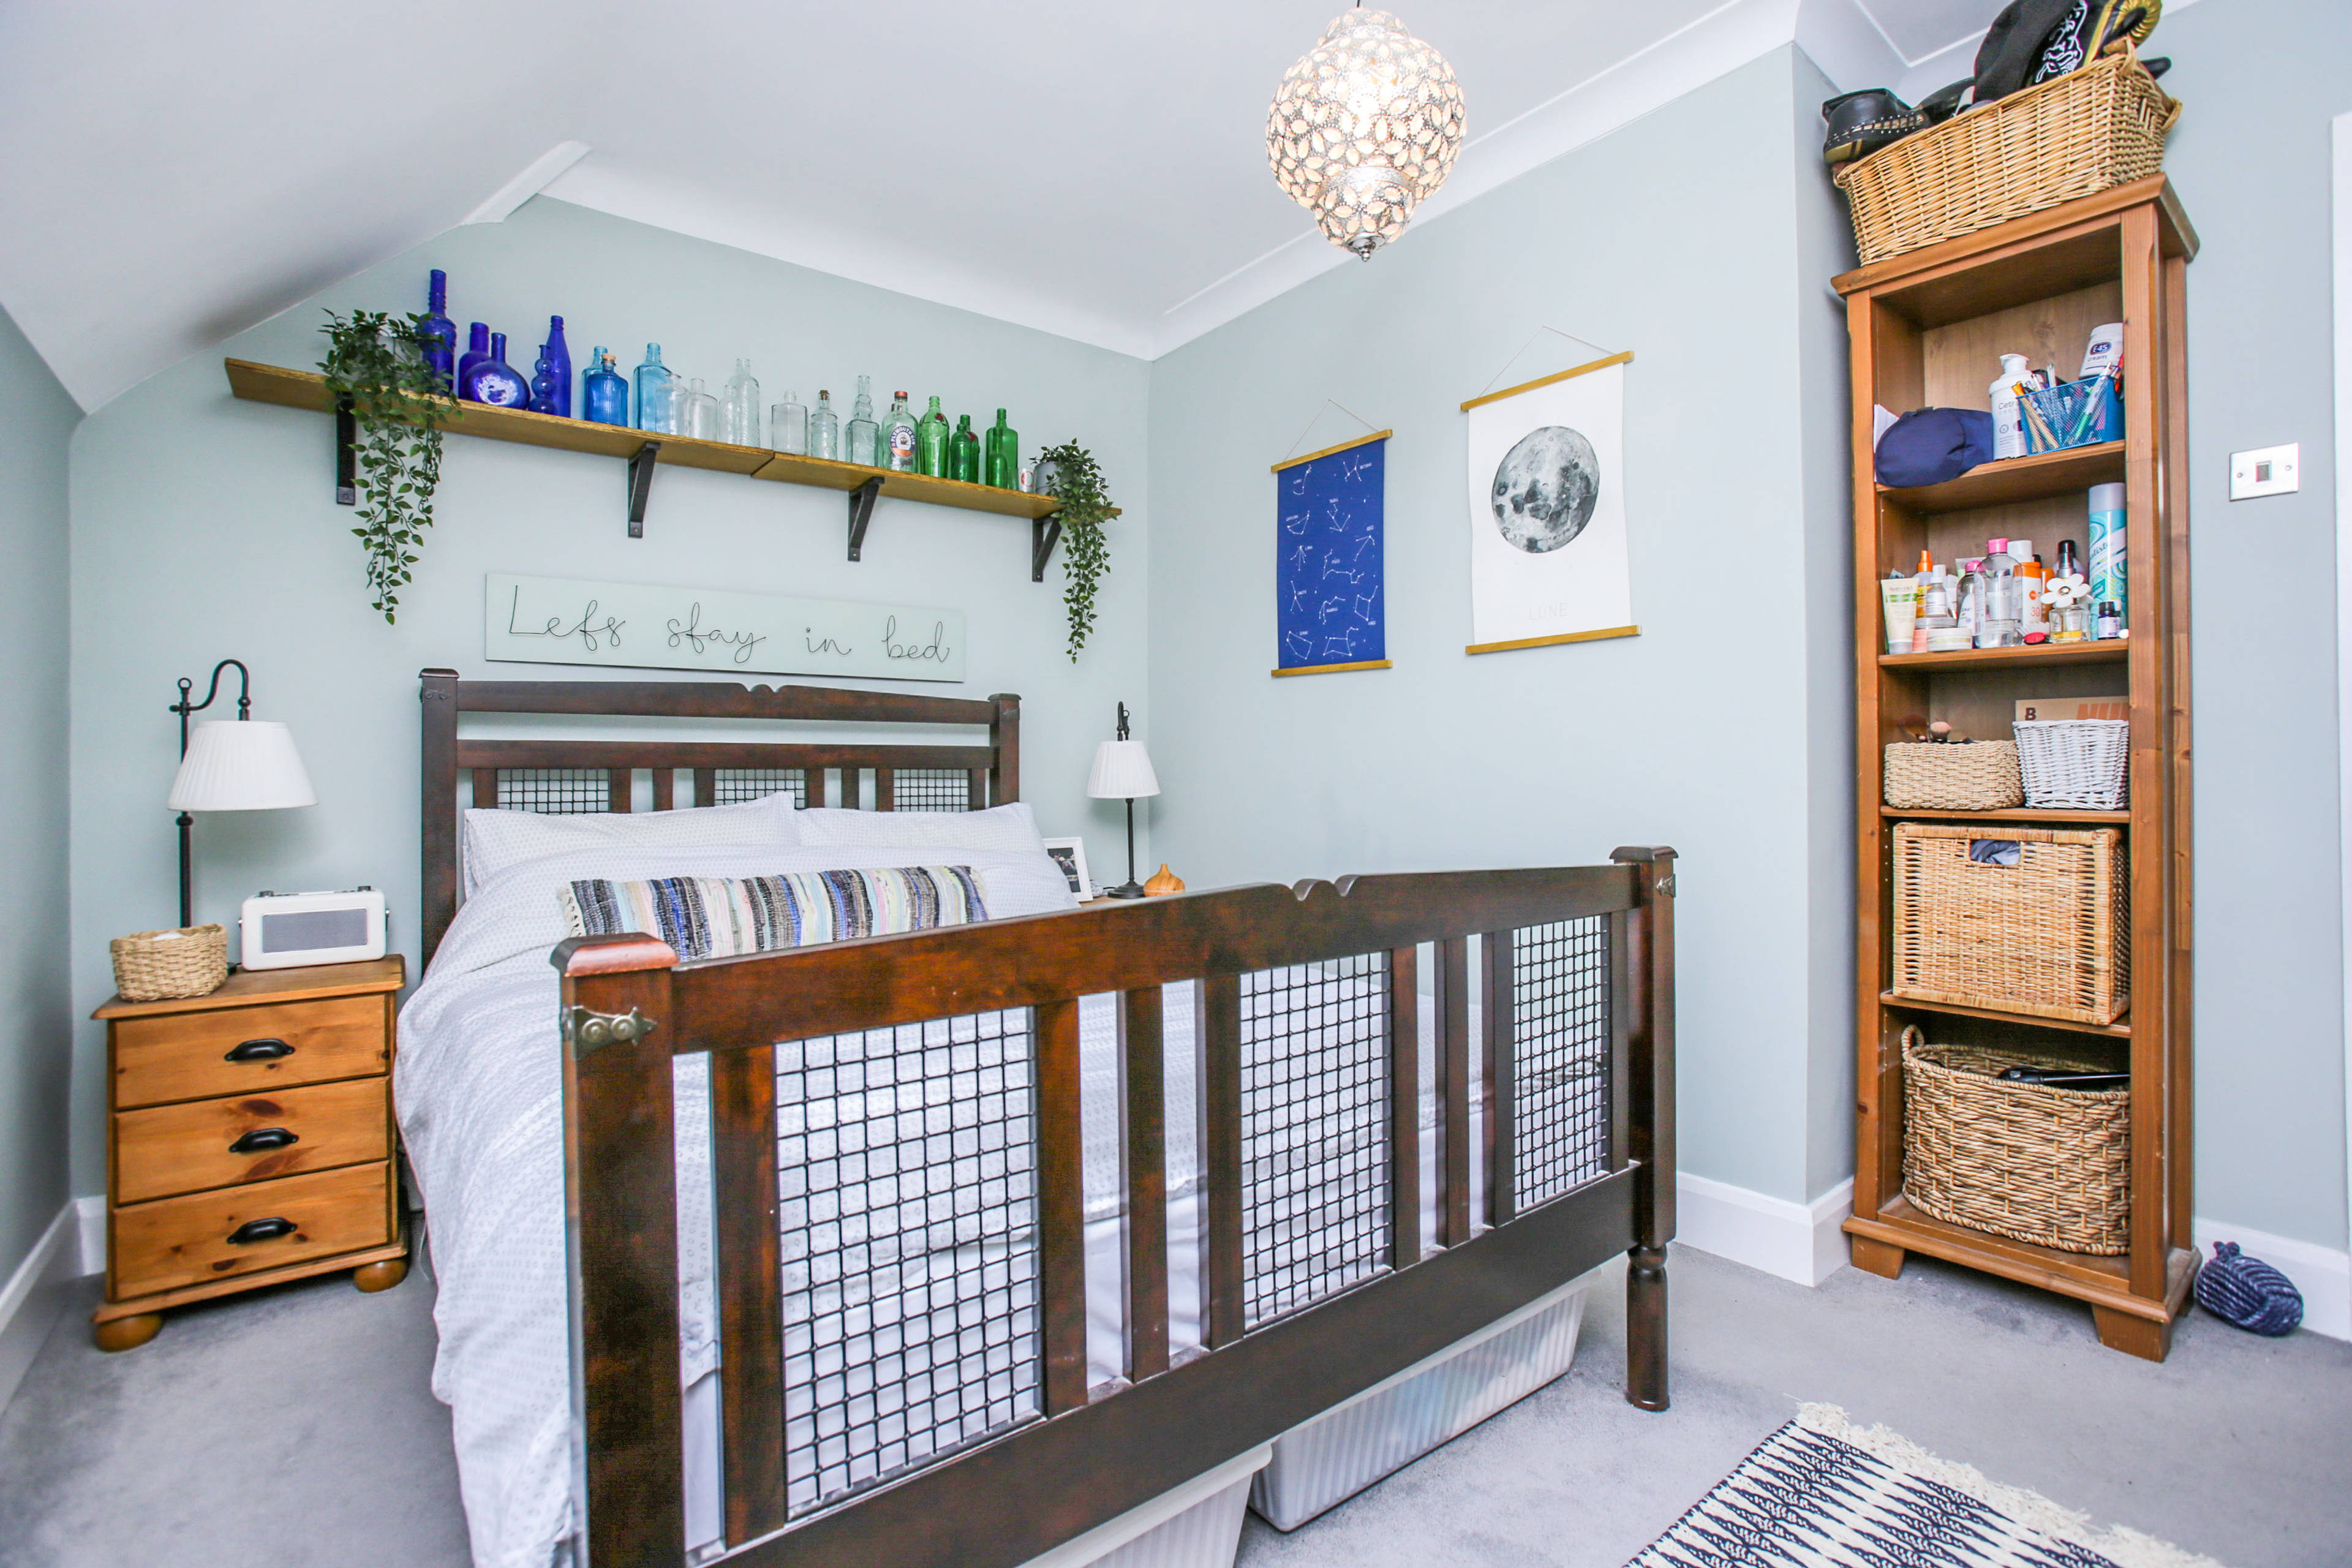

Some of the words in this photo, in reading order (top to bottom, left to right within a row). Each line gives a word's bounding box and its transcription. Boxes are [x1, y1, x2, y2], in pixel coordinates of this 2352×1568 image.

[2092, 344, 2108, 353] E45
[1998, 401, 2015, 410] Cetr
[891, 426, 913, 442] PLYMOUTH
[1529, 601, 1569, 620] LUNE
[668, 602, 766, 663] stay
[805, 627, 851, 655] in
[881, 615, 950, 662] bed
[2025, 707, 2036, 720] B
